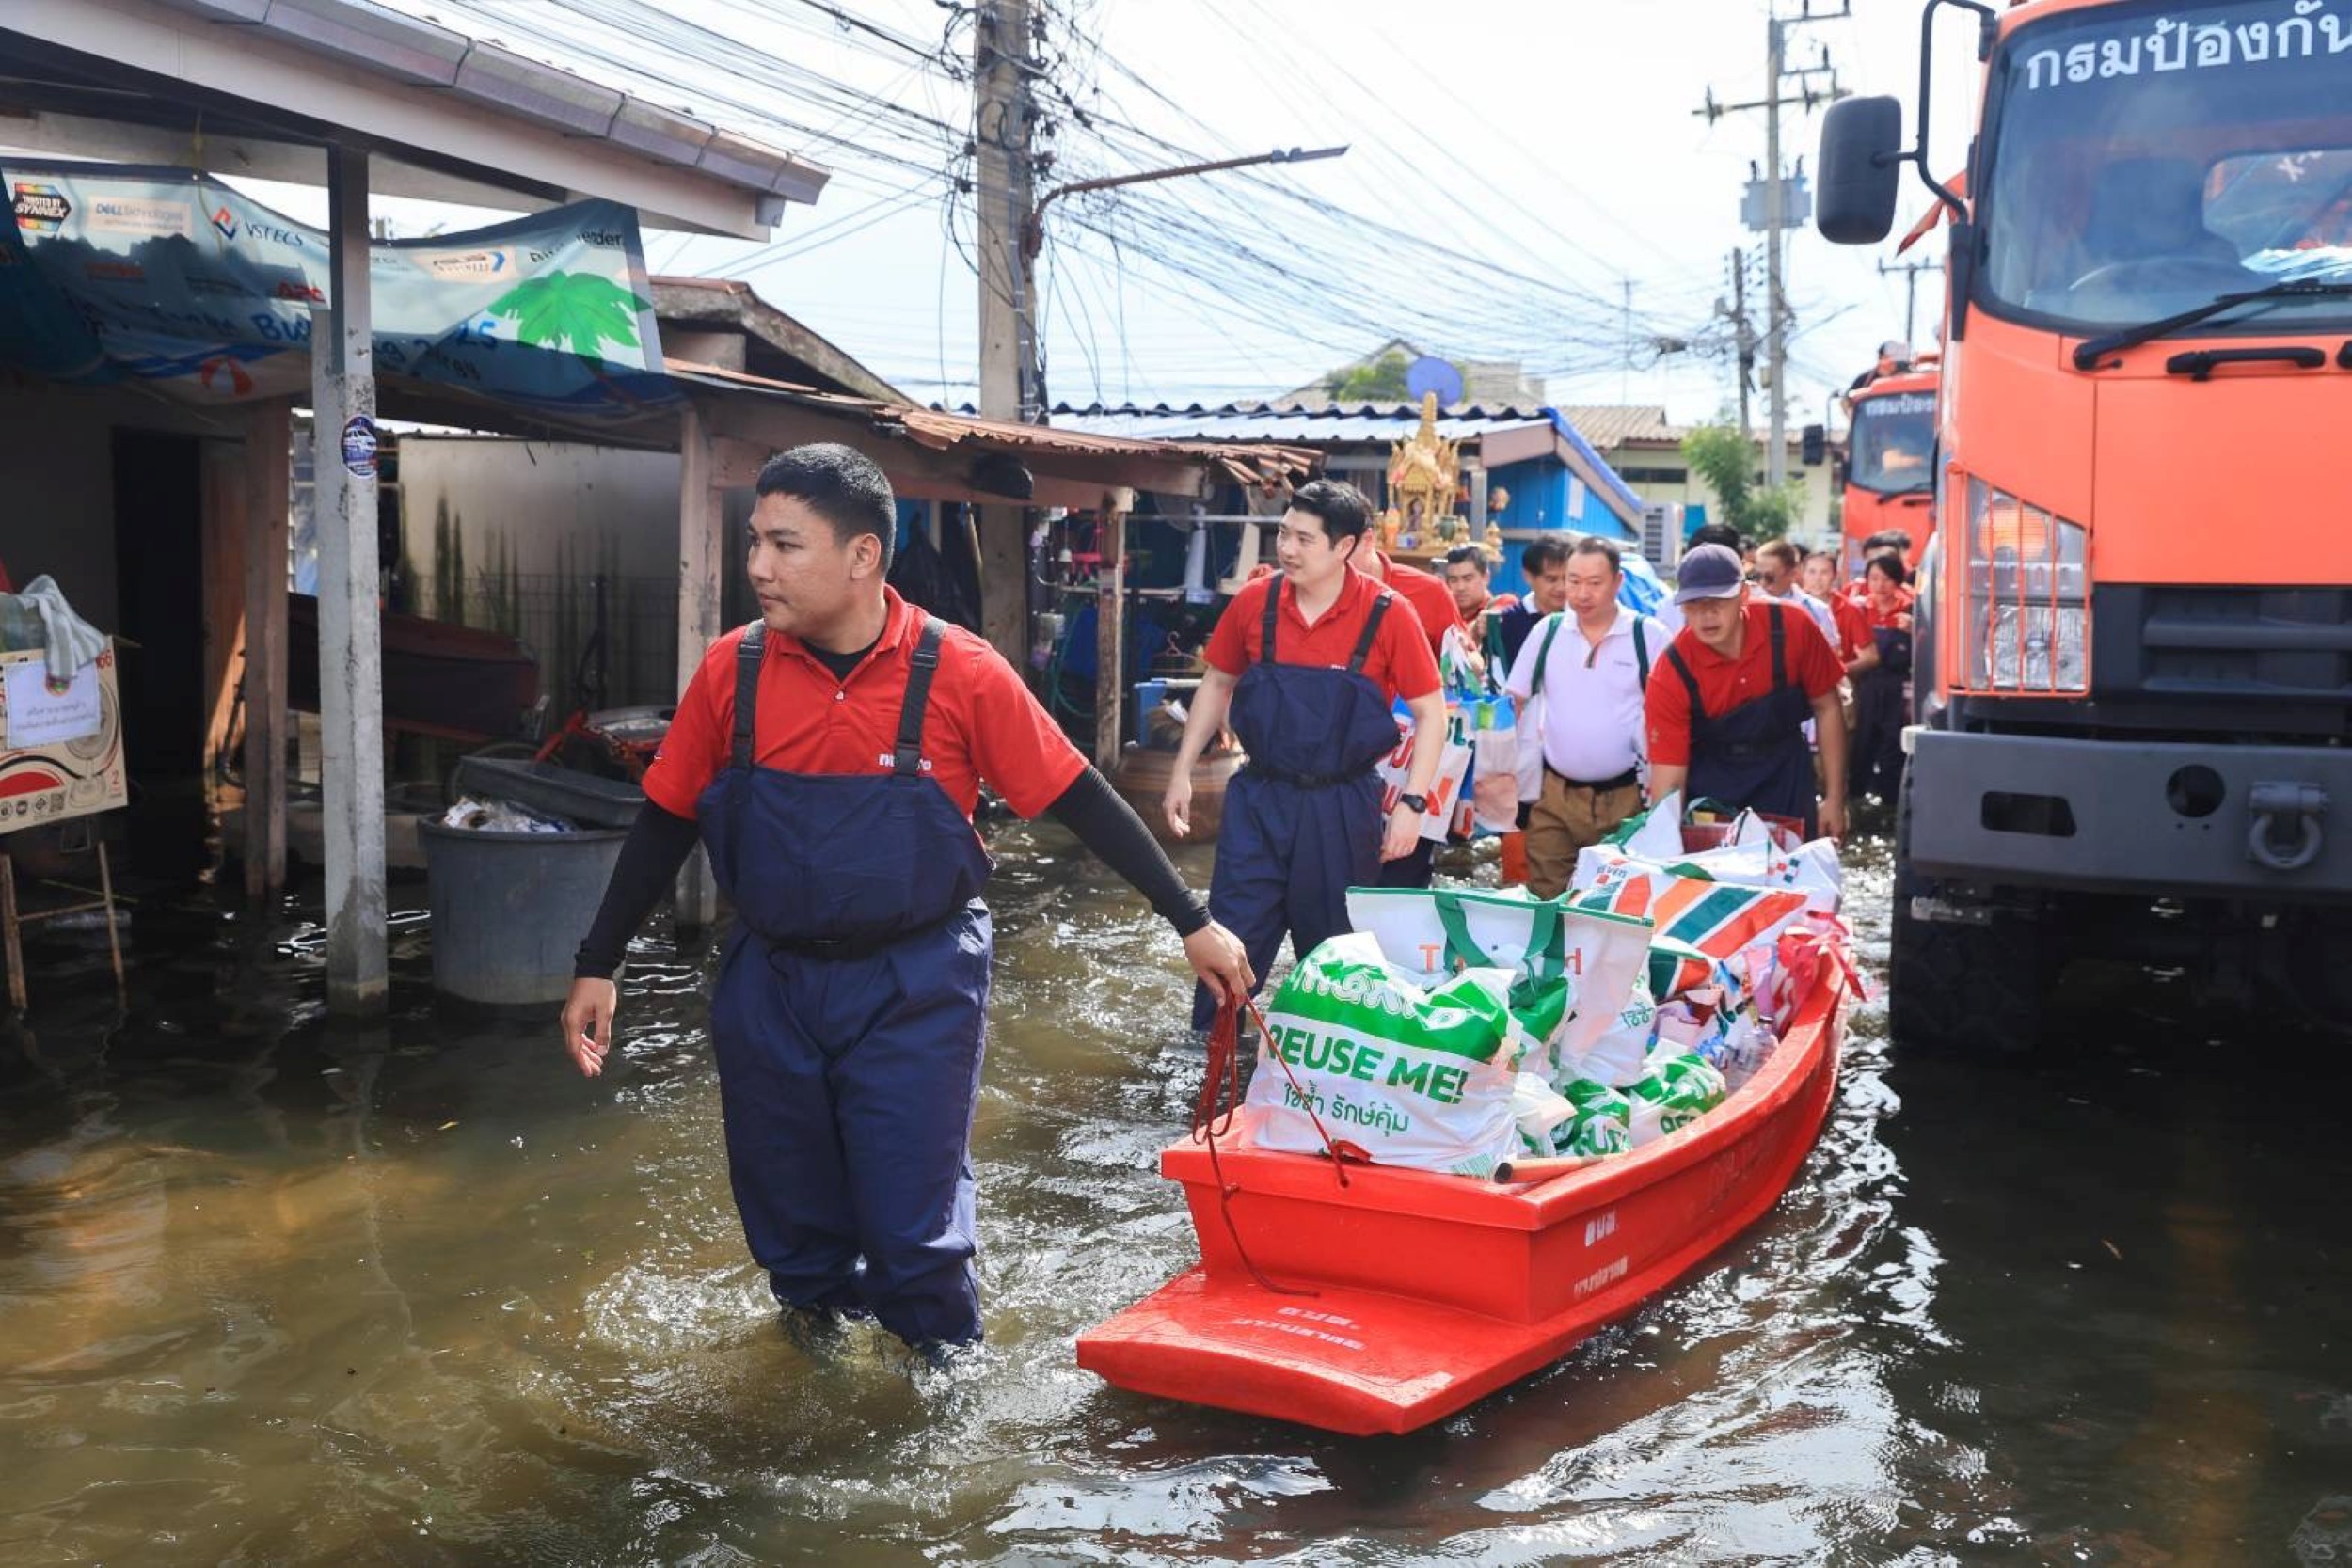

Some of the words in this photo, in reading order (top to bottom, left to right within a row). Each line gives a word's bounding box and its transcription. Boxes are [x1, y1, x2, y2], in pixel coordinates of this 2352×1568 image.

[1386, 1057, 1470, 1105] ME!
[1331, 1093, 1410, 1137] รักษ์คุ้ม
